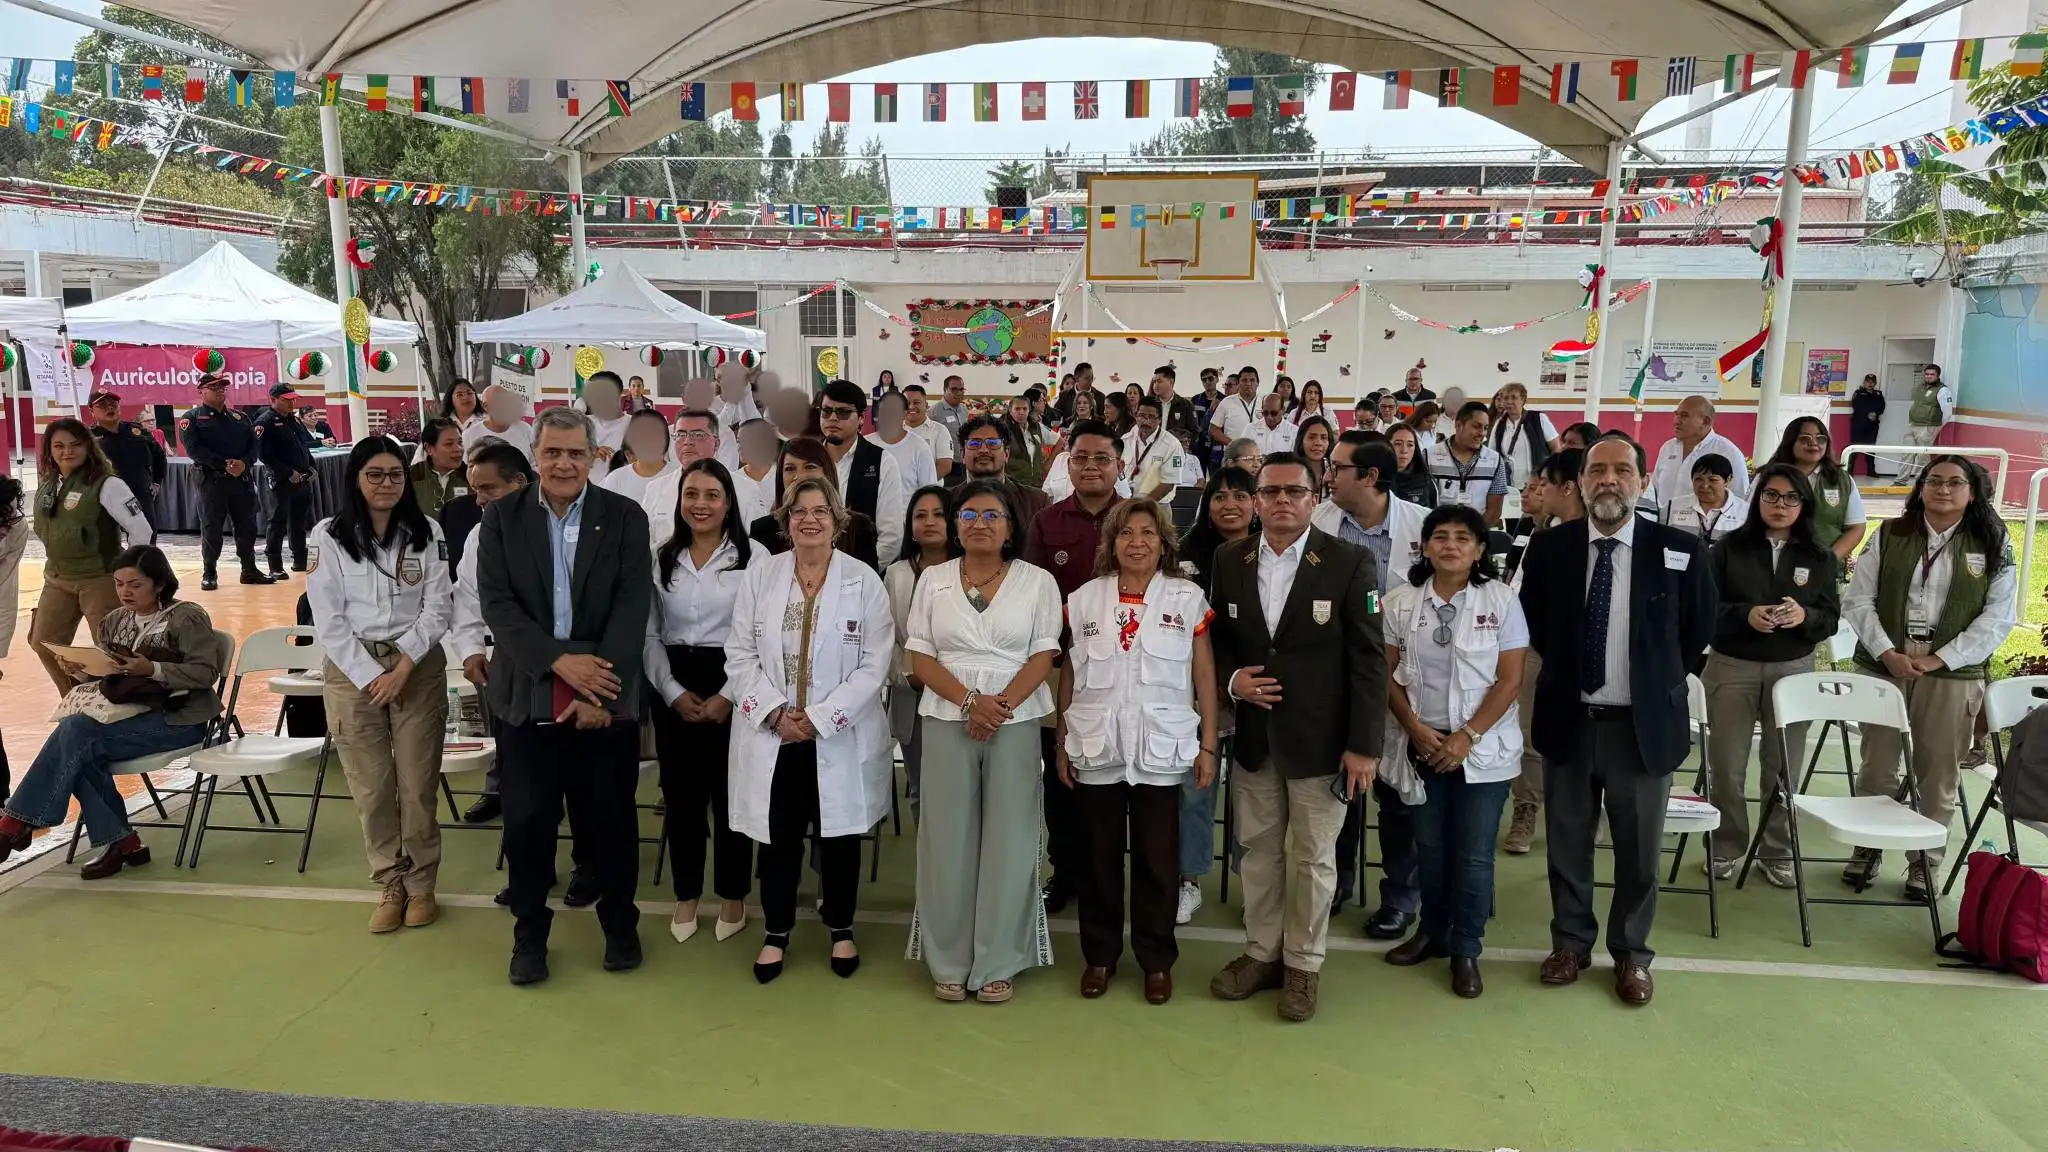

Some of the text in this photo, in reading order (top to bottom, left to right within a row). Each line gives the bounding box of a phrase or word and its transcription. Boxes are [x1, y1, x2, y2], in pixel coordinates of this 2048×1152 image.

[99, 366, 266, 389] Auriculotapia
[499, 379, 527, 393] PUESTO DE
